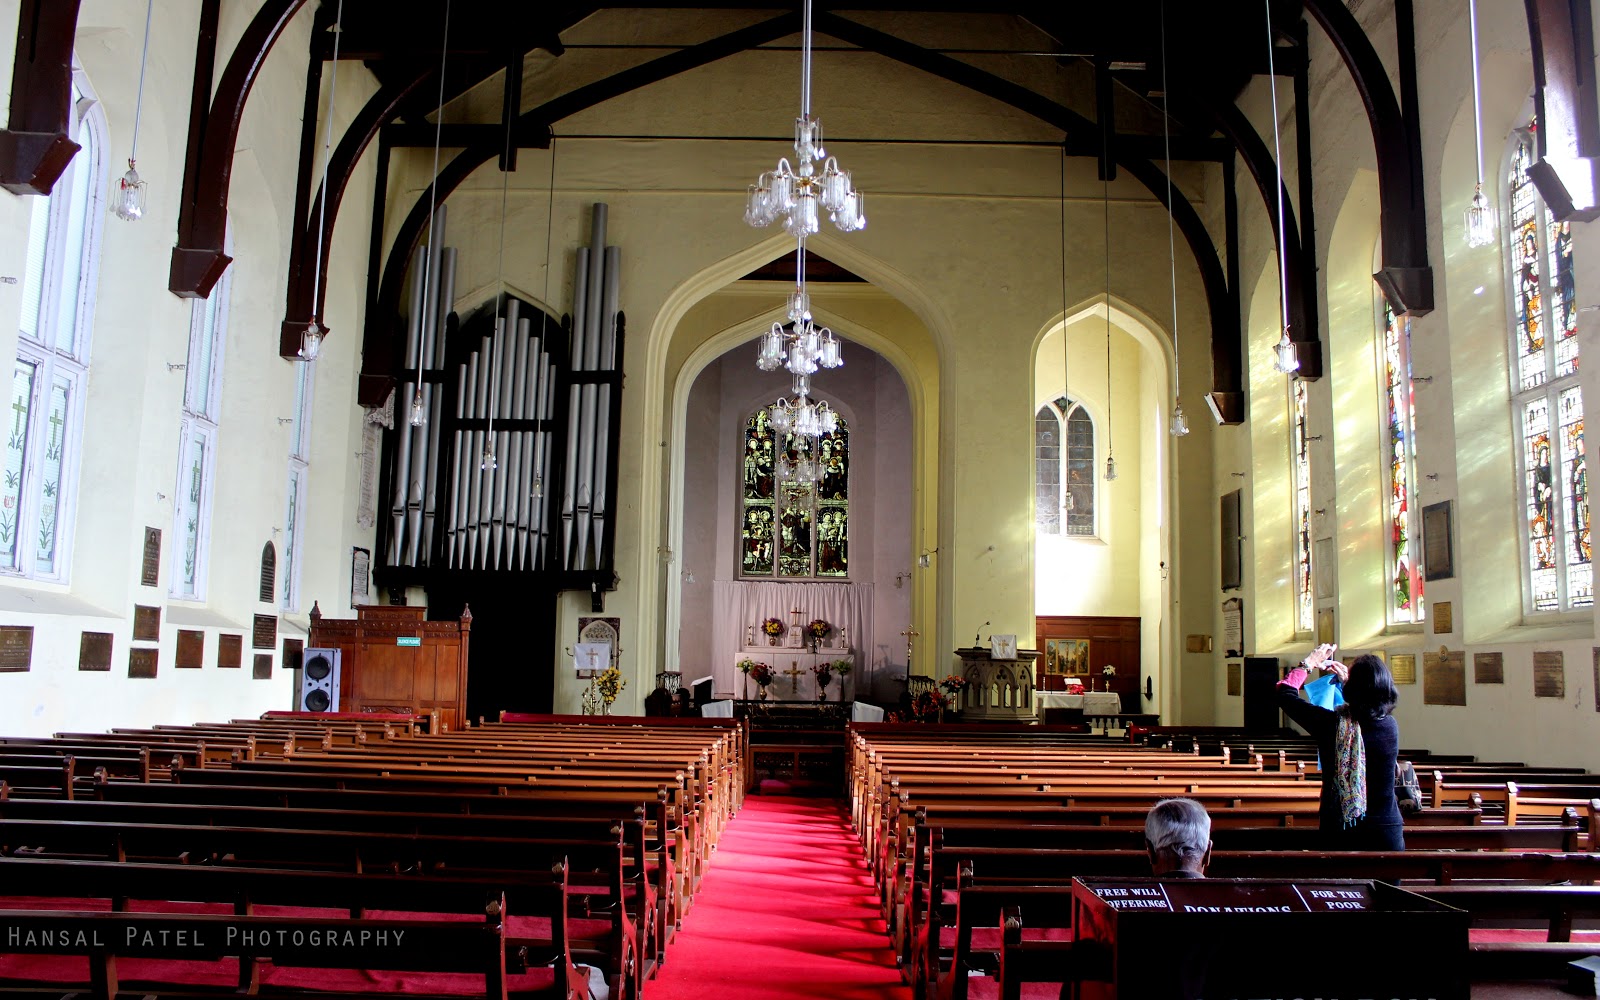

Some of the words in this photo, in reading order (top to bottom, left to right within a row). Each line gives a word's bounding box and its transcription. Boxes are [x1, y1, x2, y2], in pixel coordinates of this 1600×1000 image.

[1095, 888, 1129, 897] FREE
[1130, 888, 1161, 896] WILL
[1310, 890, 1336, 898] FOR
[1337, 891, 1364, 899] THE
[1107, 900, 1168, 908] OFFERINGS
[1325, 901, 1365, 910] POOR
